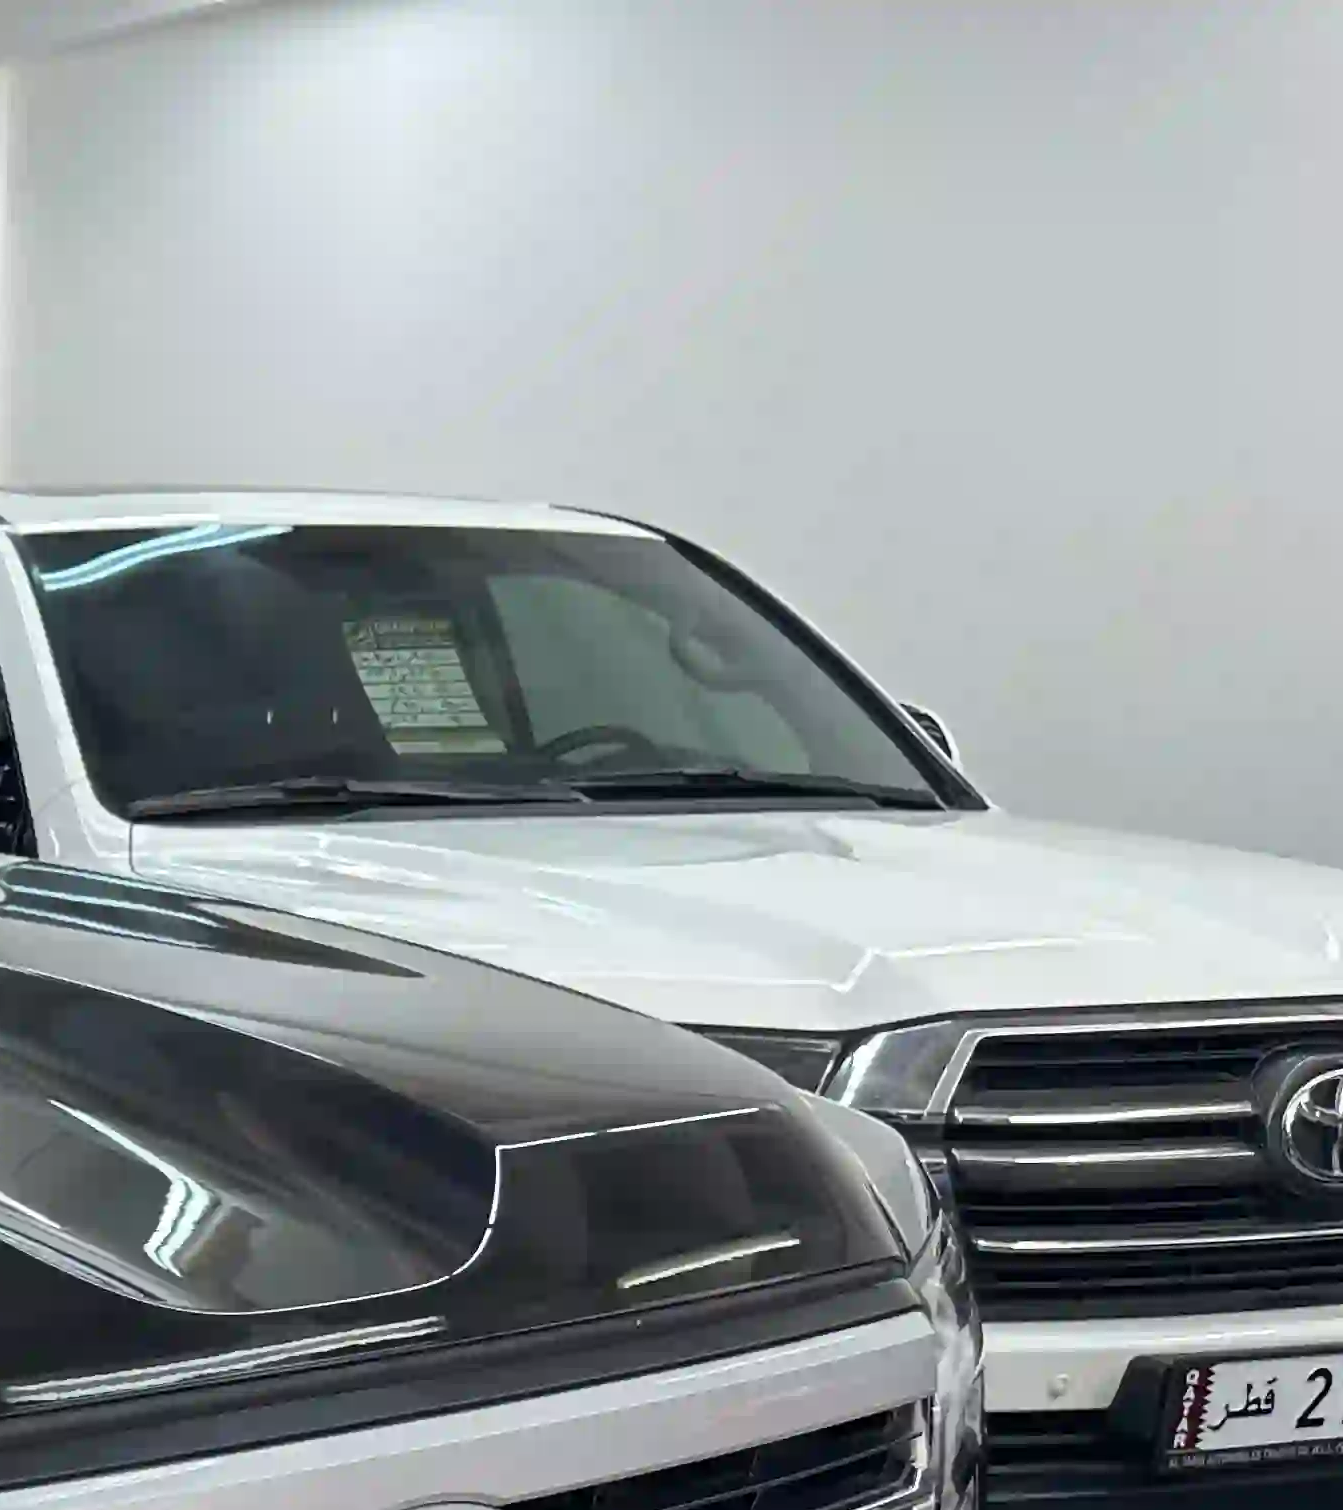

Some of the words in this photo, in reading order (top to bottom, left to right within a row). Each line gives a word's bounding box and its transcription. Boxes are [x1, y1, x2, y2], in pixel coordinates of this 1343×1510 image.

[1173, 1369, 1200, 1449] QATAR
[1206, 1376, 1279, 1431] قطر
[1295, 1367, 1343, 1429] 2
